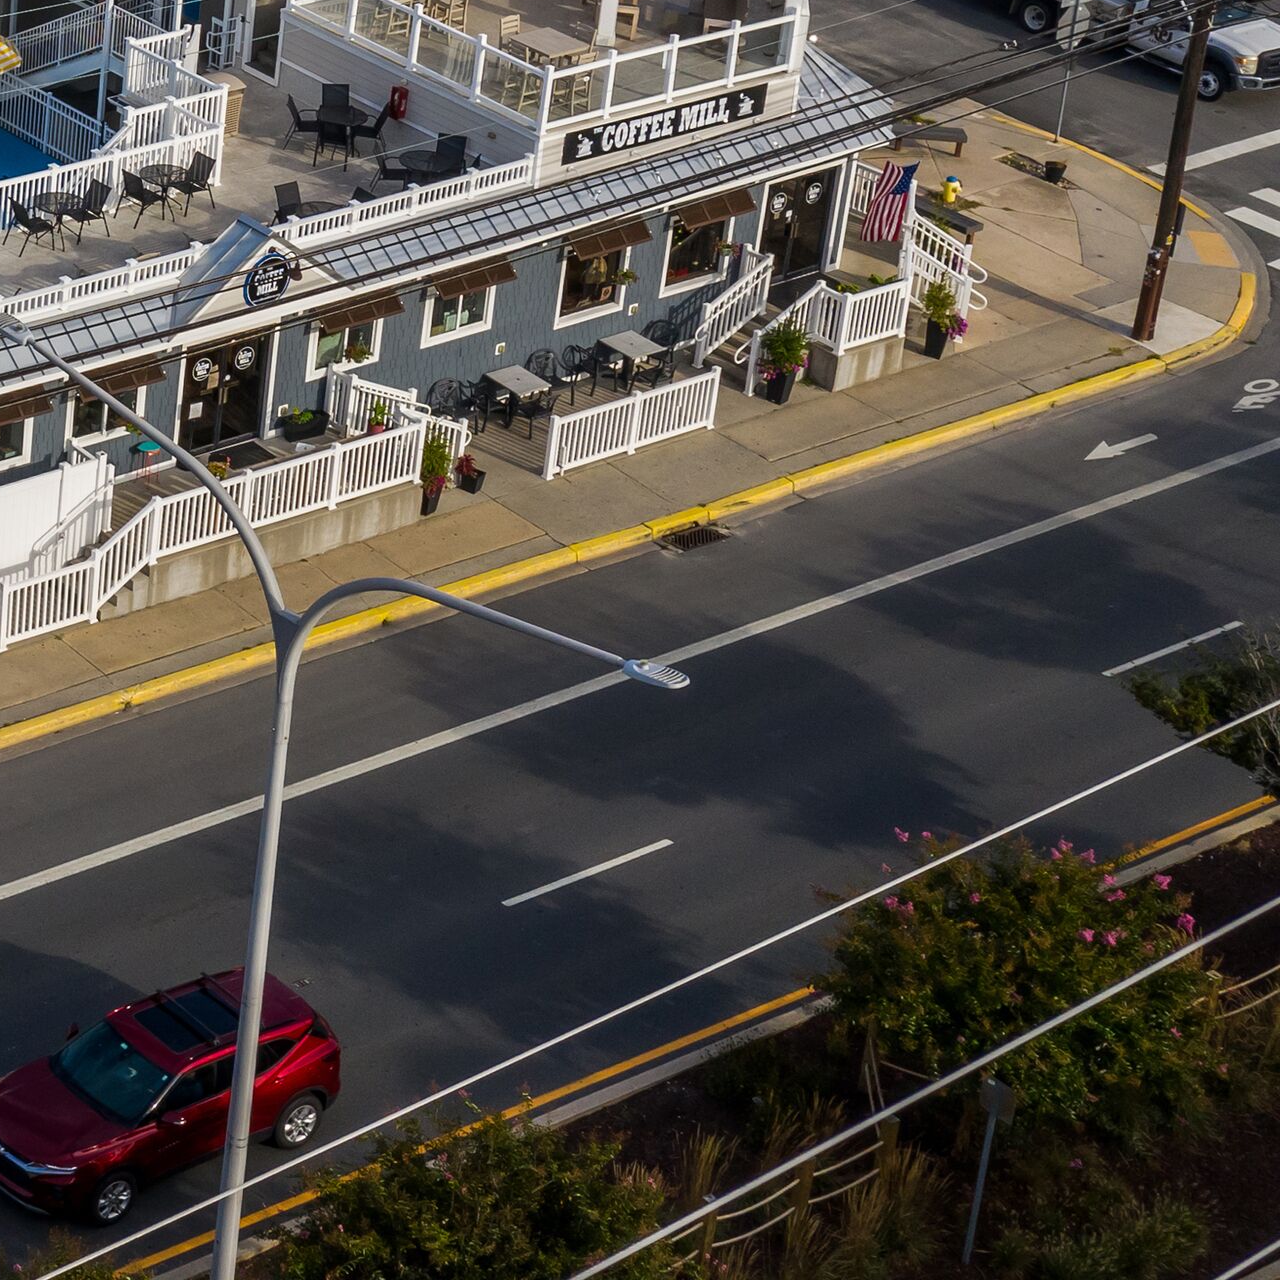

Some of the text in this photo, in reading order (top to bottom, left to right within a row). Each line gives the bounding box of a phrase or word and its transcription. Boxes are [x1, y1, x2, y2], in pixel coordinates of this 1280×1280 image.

[601, 97, 730, 152] COFFEE MILL
[256, 282, 278, 296] MILL
